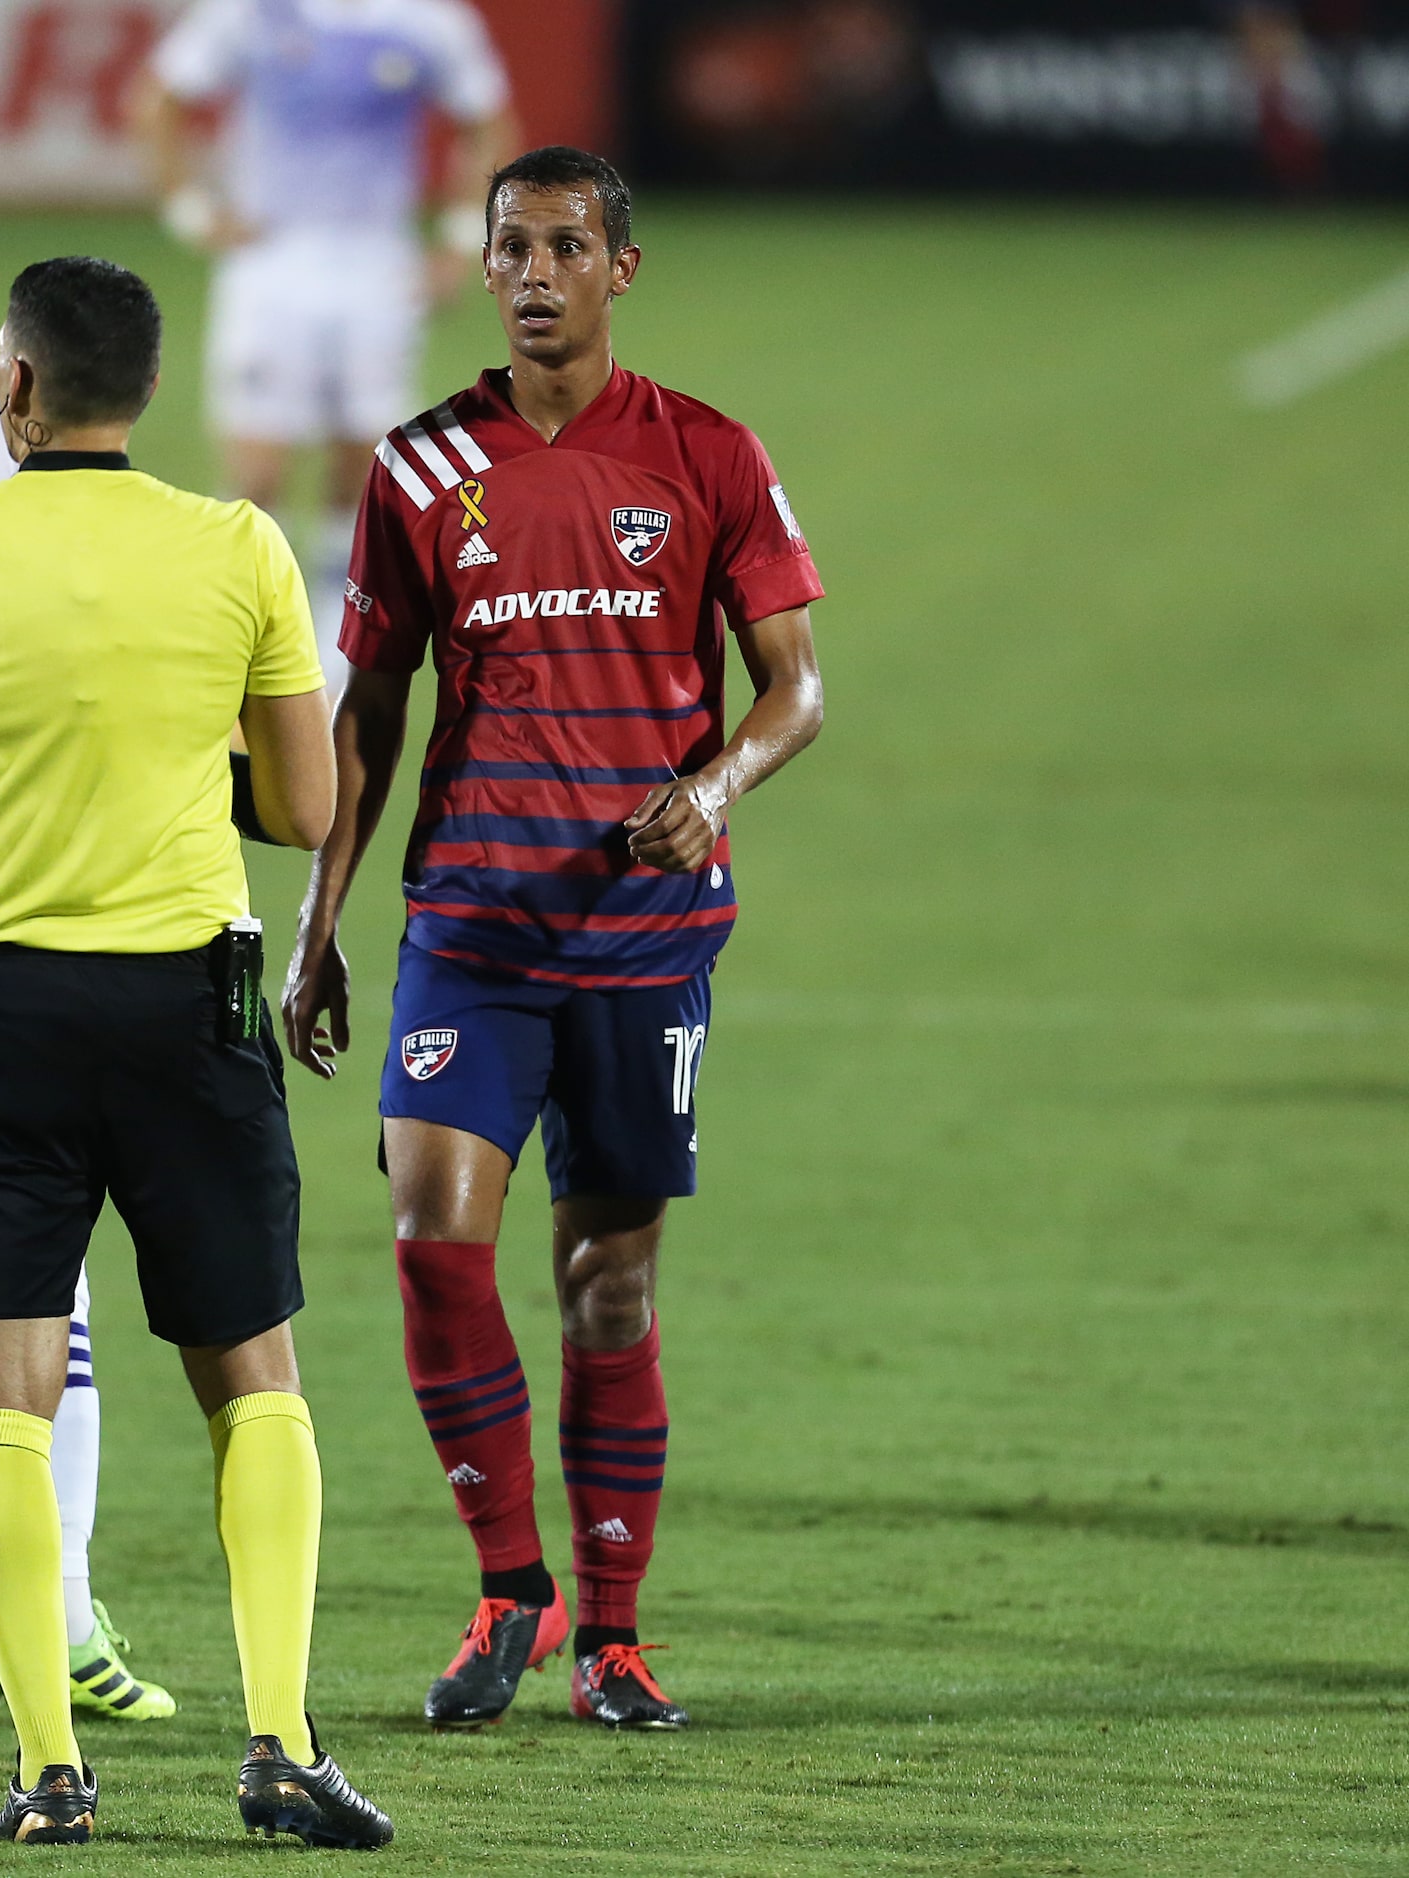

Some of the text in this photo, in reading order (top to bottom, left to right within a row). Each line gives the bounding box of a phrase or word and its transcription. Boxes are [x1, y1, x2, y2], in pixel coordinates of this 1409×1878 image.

[615, 511, 665, 529] FC DALLAS
[456, 552, 499, 570] adidas
[463, 588, 661, 629] ADVOCARE
[406, 1033, 453, 1051] FC DALLAS
